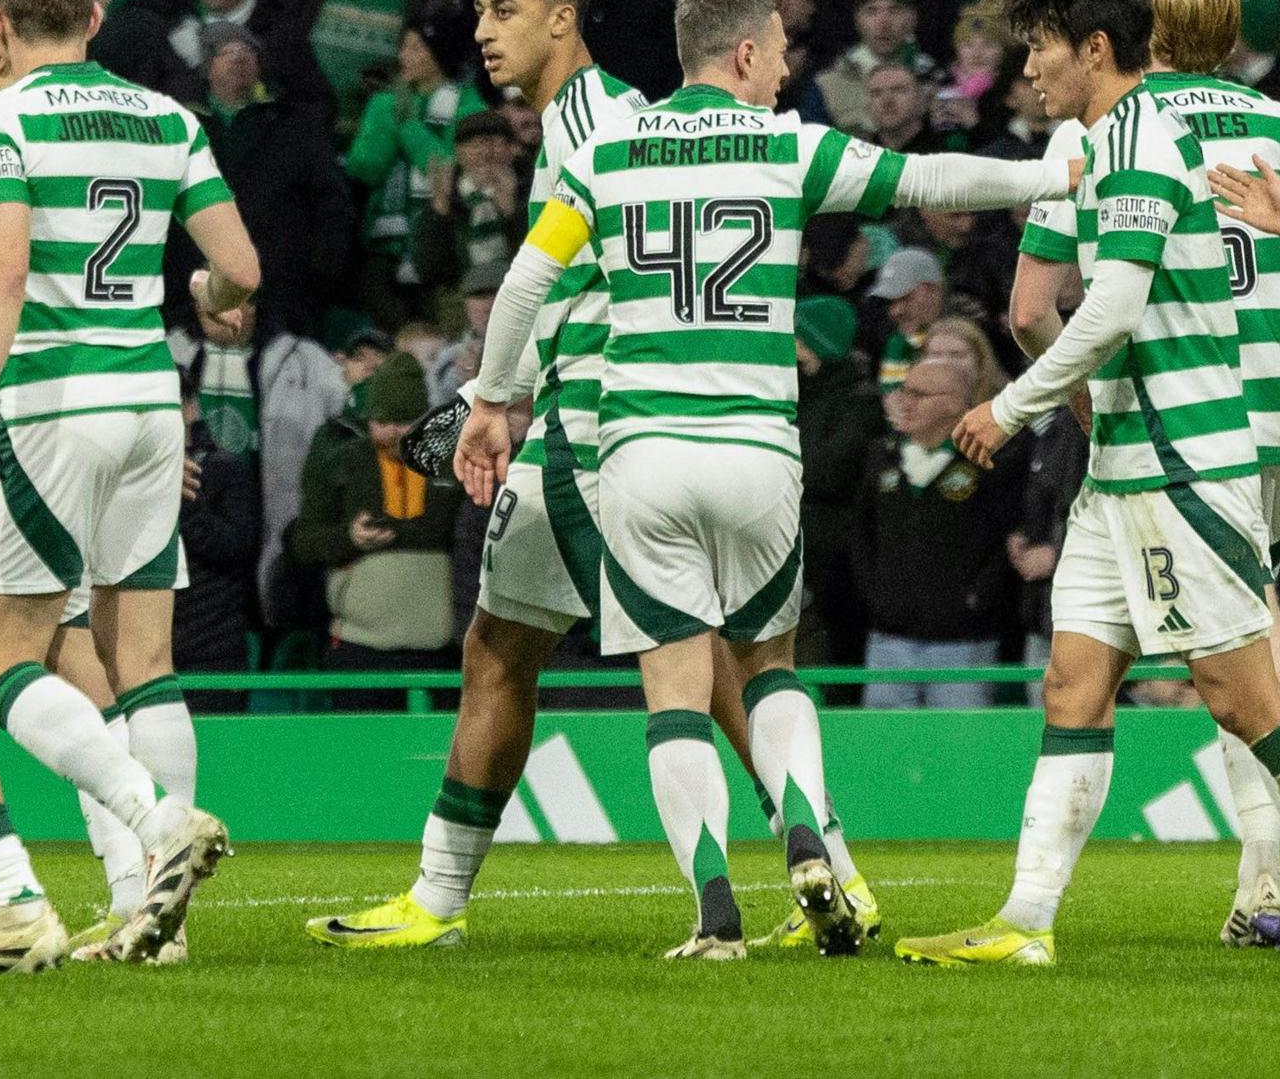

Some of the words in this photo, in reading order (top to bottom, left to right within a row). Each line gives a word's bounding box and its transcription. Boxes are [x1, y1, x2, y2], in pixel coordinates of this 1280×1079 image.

[44, 88, 149, 111] MAGNERS
[1160, 91, 1255, 109] AGNERS
[58, 111, 164, 145] JOHNSTON
[637, 113, 765, 133] MAGNERS
[0, 148, 13, 162] FC
[628, 134, 768, 167] McGREGOR
[1116, 198, 1146, 213] CELTIC
[1148, 200, 1160, 215] FC
[1113, 214, 1169, 234] FOUNDATION
[84, 177, 142, 302] 2
[622, 198, 773, 325] 42
[488, 487, 518, 541] 9
[1141, 546, 1180, 601] 13
